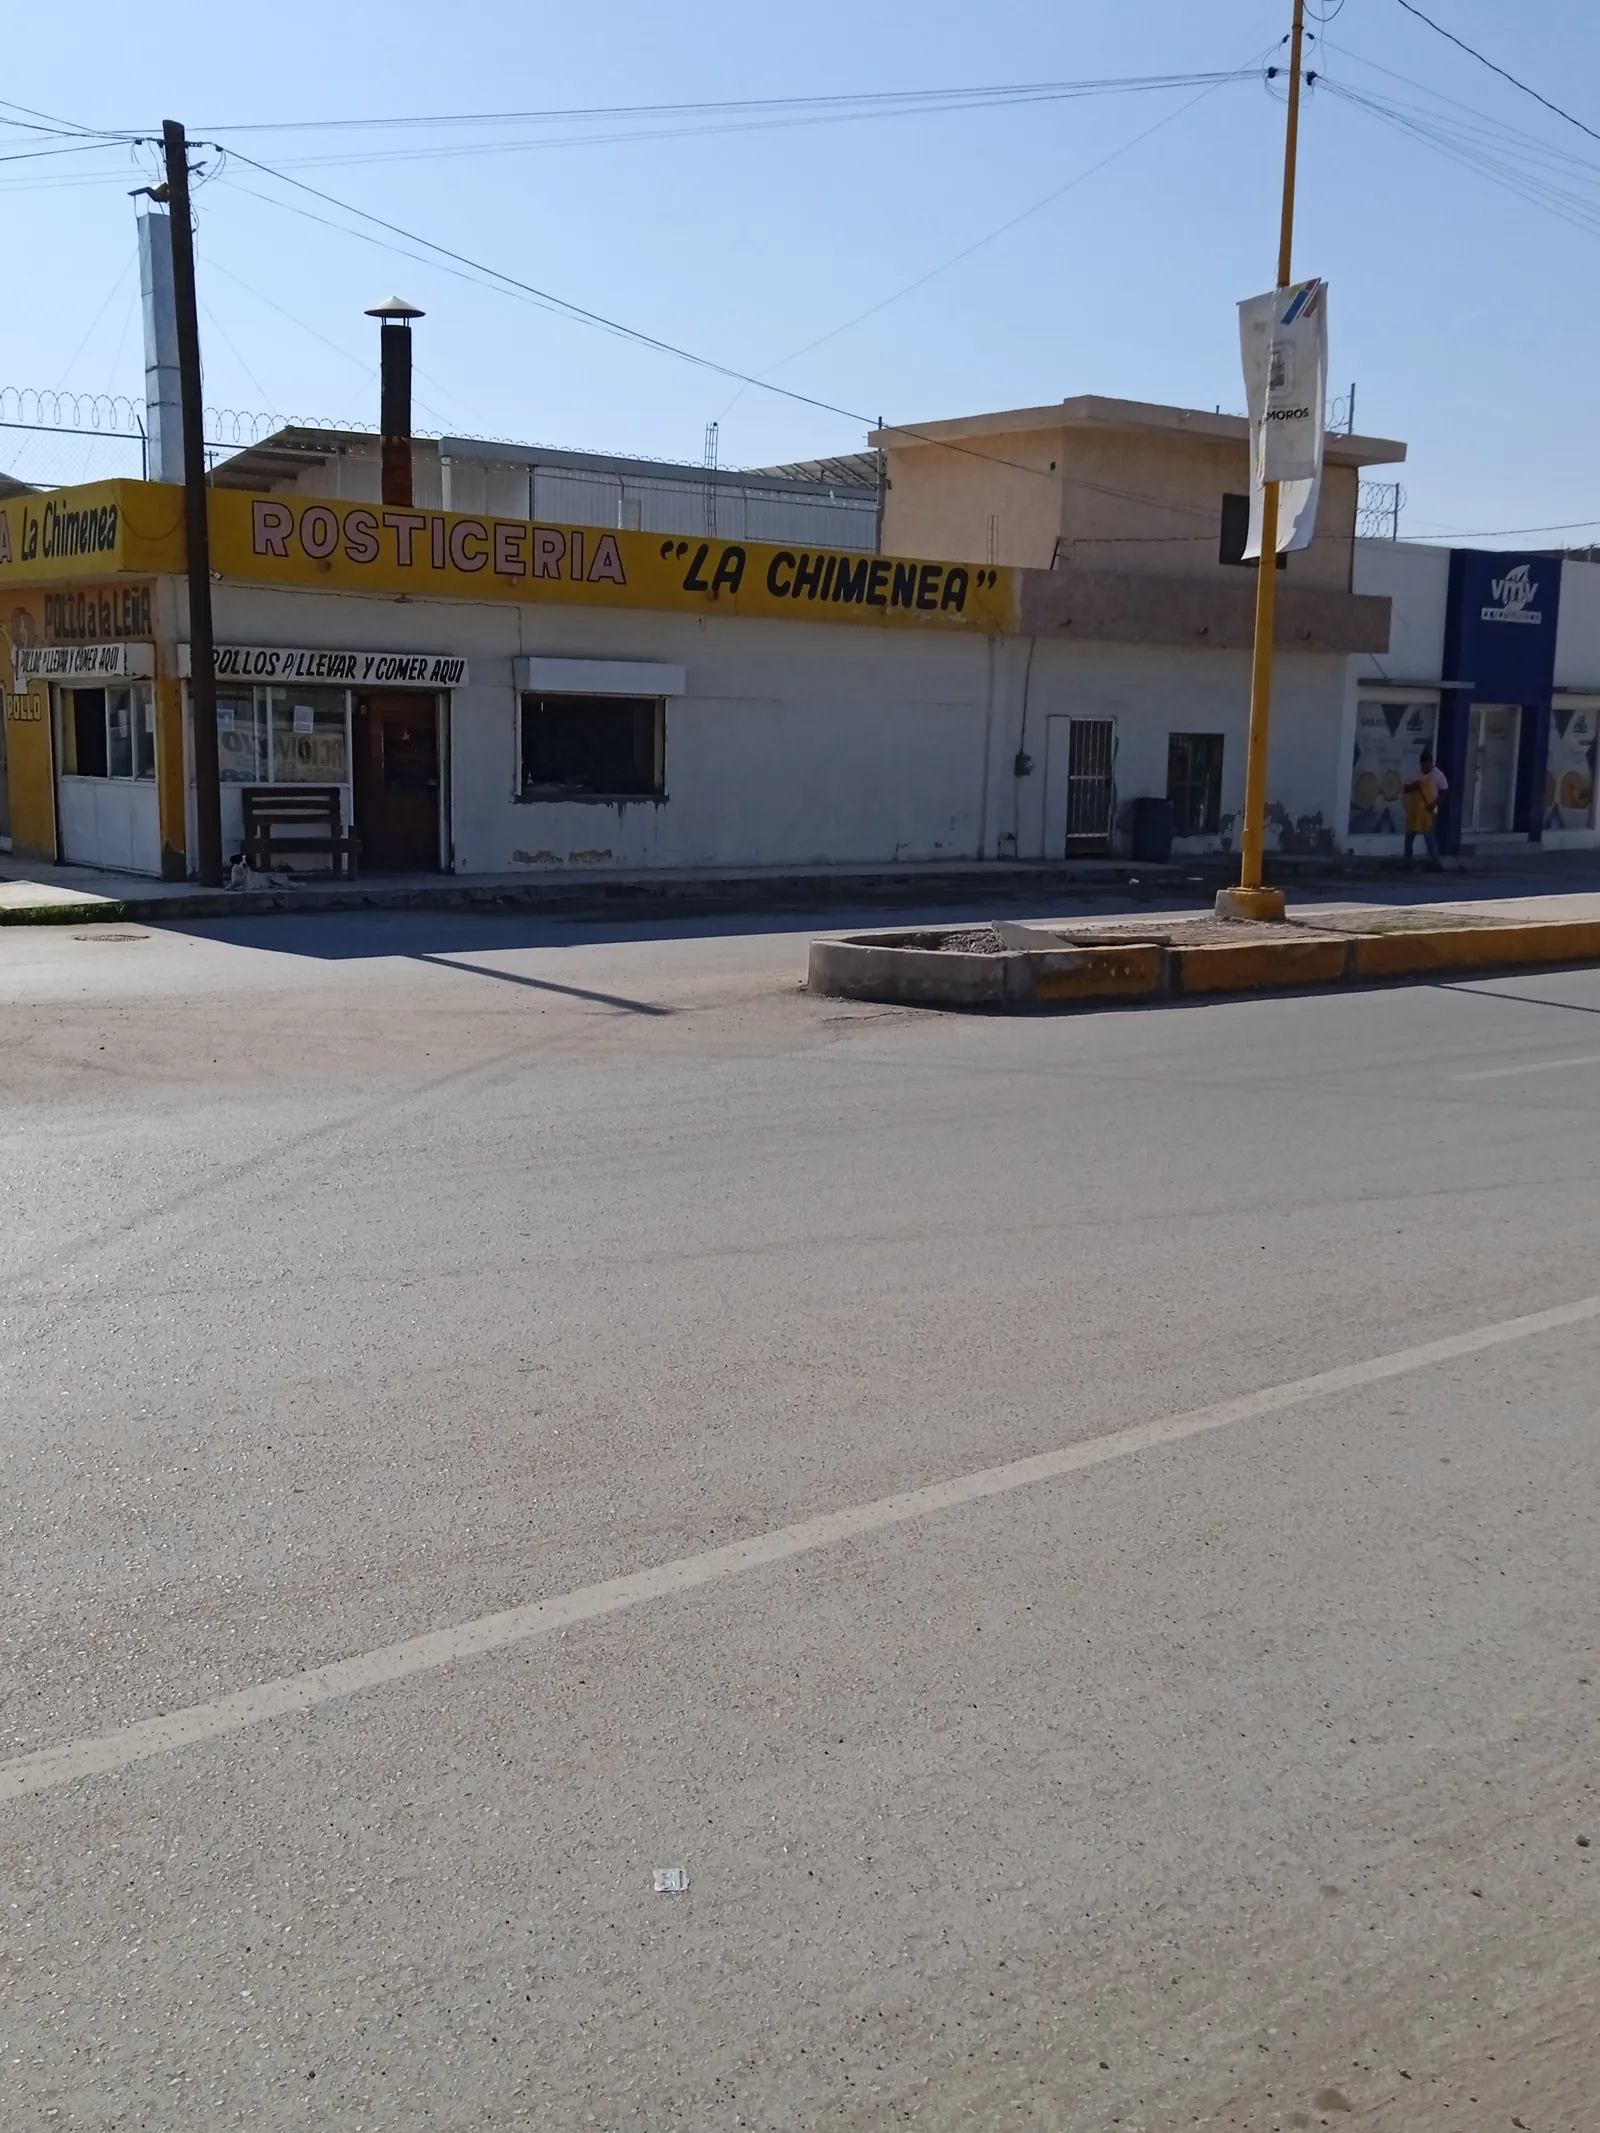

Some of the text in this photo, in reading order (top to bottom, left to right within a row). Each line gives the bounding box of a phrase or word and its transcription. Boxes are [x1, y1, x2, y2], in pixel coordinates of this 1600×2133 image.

[21, 506, 38, 561] La
[42, 500, 118, 558] Chimenea
[251, 500, 627, 585] ROSTICERIA
[44, 592, 87, 639] POLLO
[87, 600, 97, 638] a
[113, 586, 153, 638] LEÑA
[99, 646, 120, 672] AQUI
[362, 656, 375, 680] Y
[375, 657, 428, 681] COMER
[429, 659, 465, 685] AQUI
[6, 693, 42, 722] POLLO
